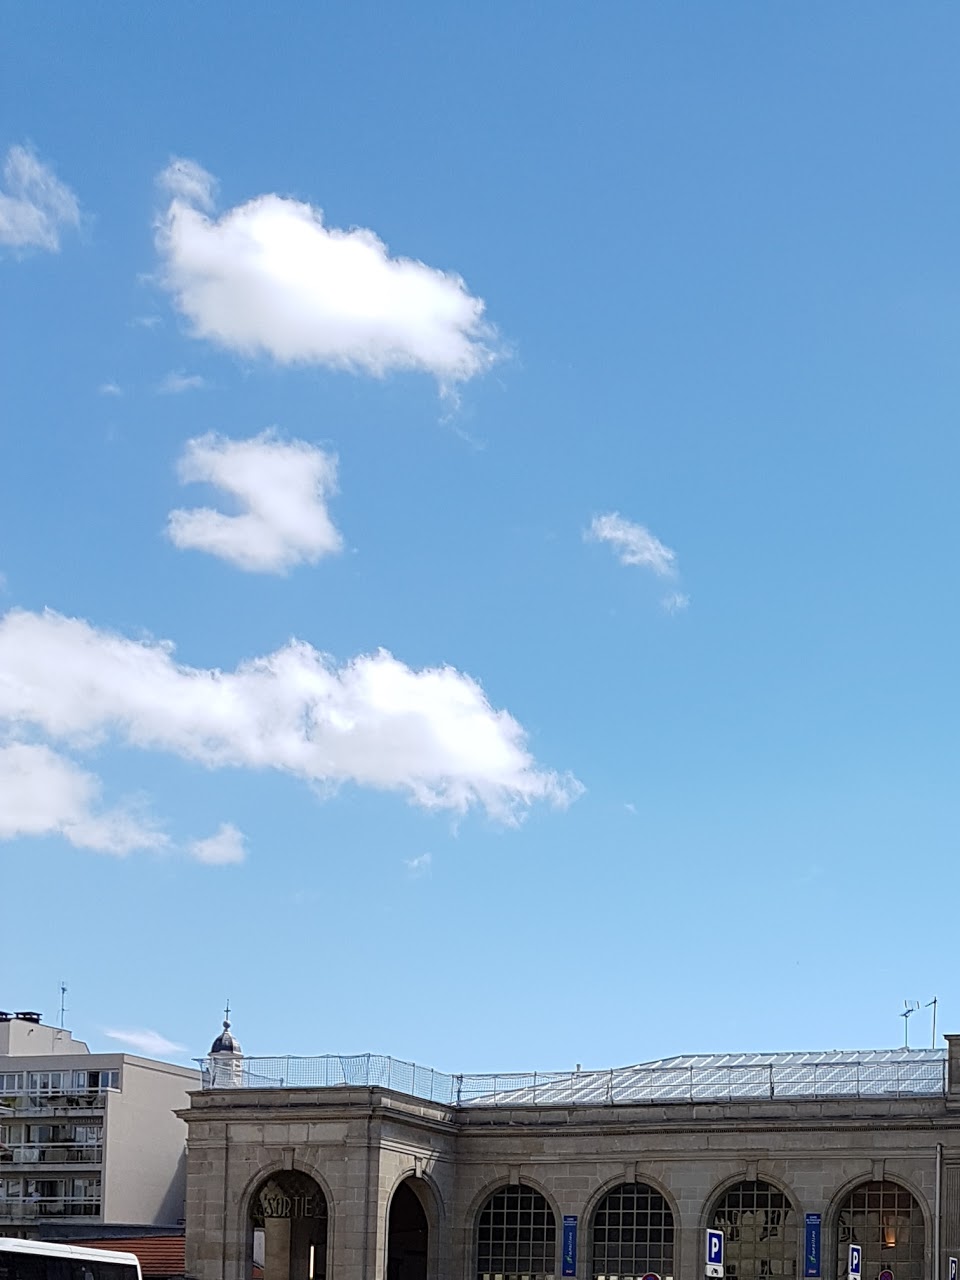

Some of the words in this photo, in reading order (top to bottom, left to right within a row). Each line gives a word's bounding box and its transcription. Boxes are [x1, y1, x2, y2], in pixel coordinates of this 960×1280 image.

[263, 1196, 313, 1217] SORTIE
[711, 1236, 719, 1259] P
[852, 1251, 859, 1269] P
